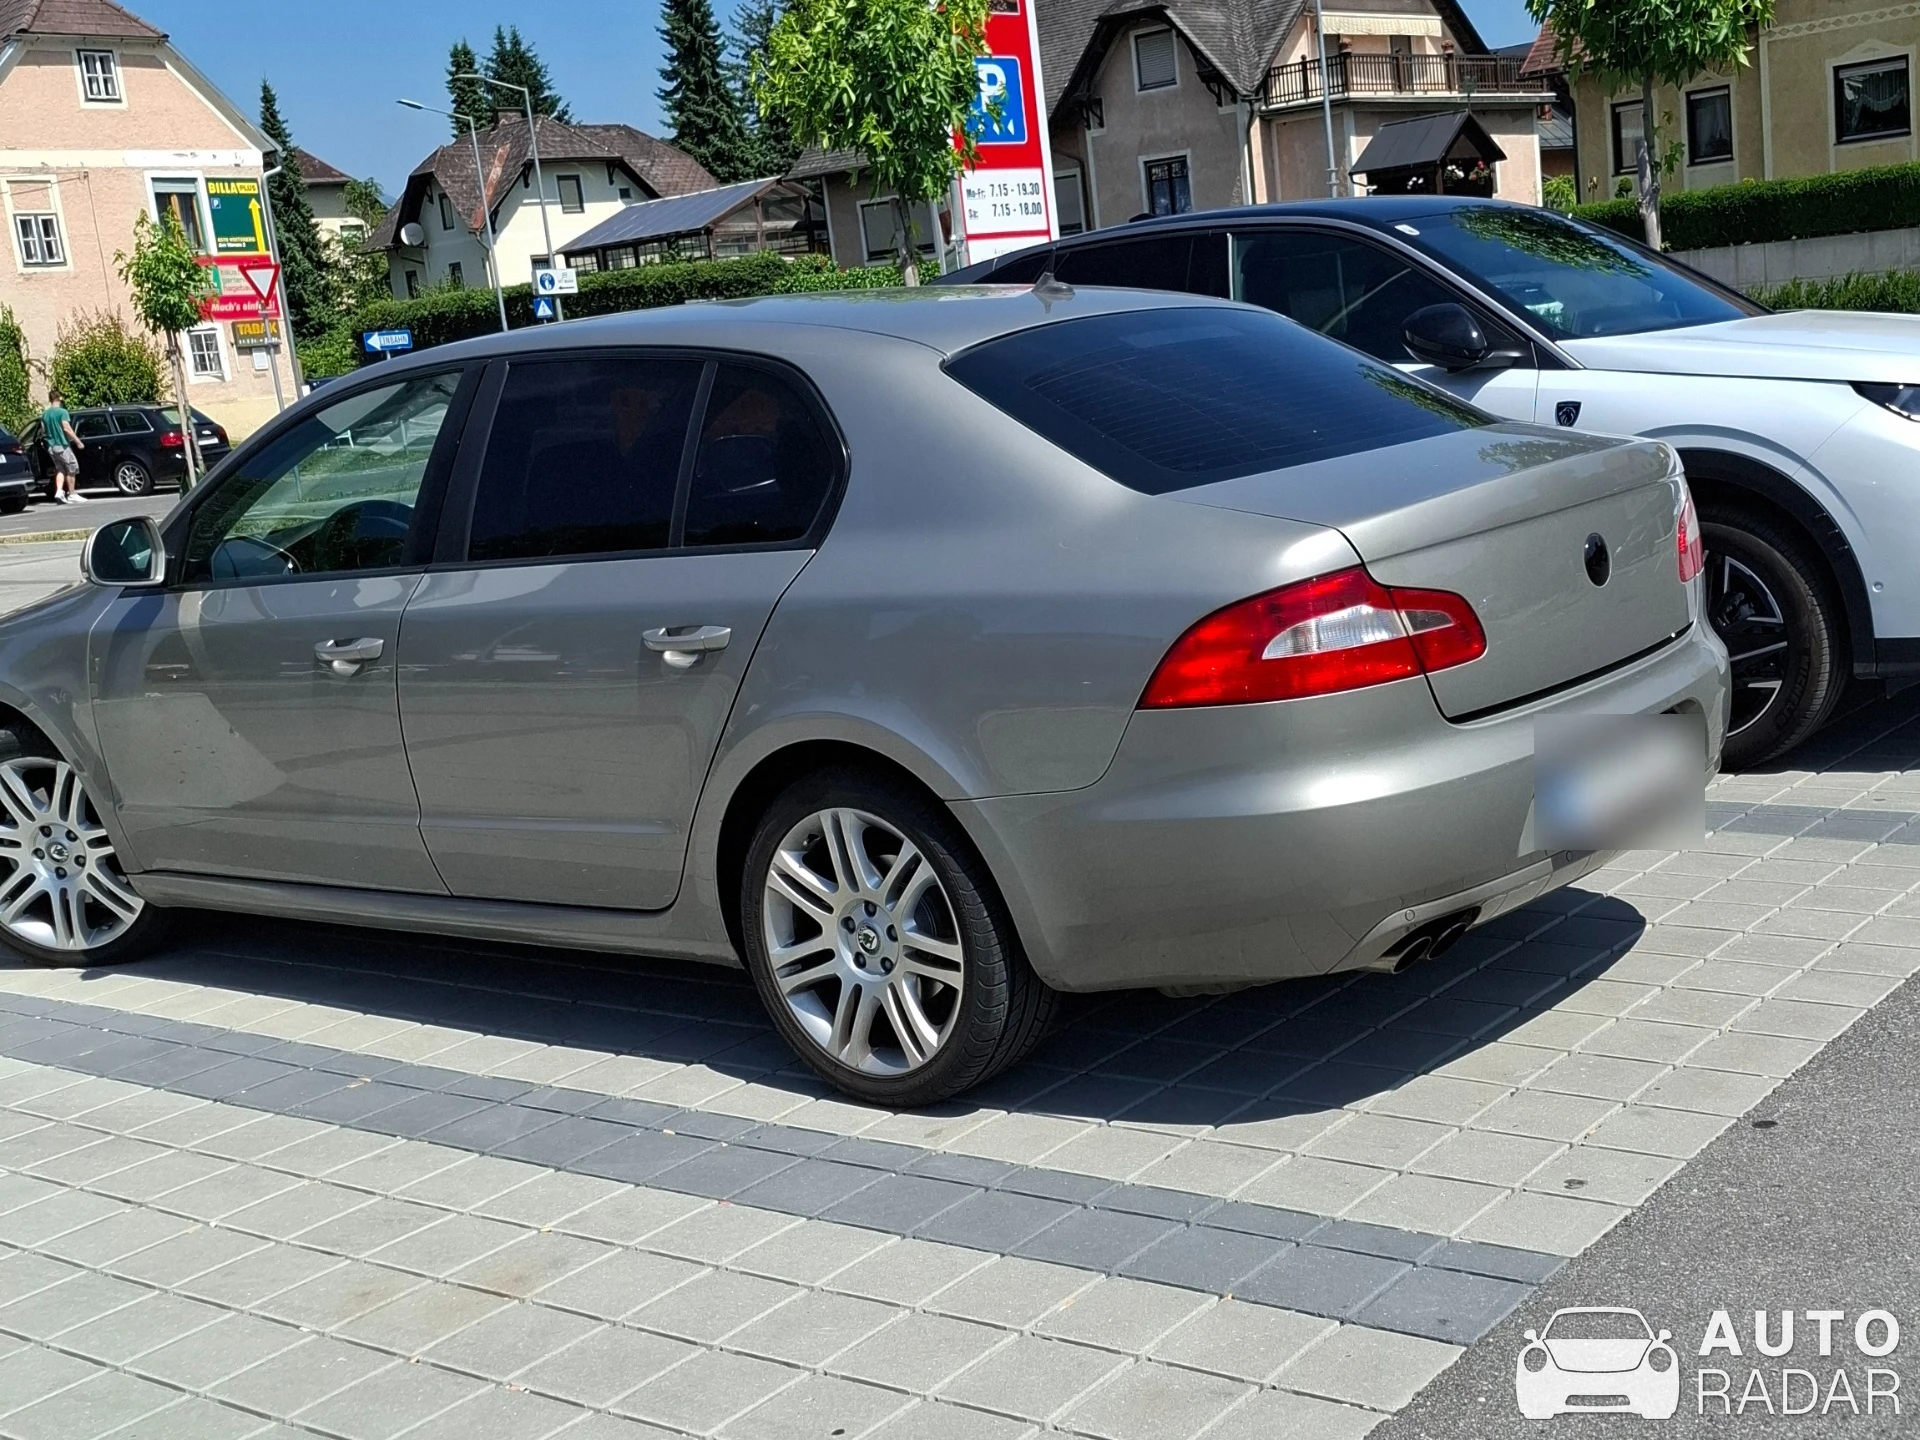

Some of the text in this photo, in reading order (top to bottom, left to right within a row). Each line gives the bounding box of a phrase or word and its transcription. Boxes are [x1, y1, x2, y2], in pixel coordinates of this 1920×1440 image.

[208, 182, 256, 194] BILLA PLUS
[989, 183, 1009, 197] 7.15
[1016, 182, 1040, 196] 19.30
[992, 203, 1011, 217] 7.15
[1018, 201, 1043, 216] 18.00
[211, 302, 241, 312] Mach's
